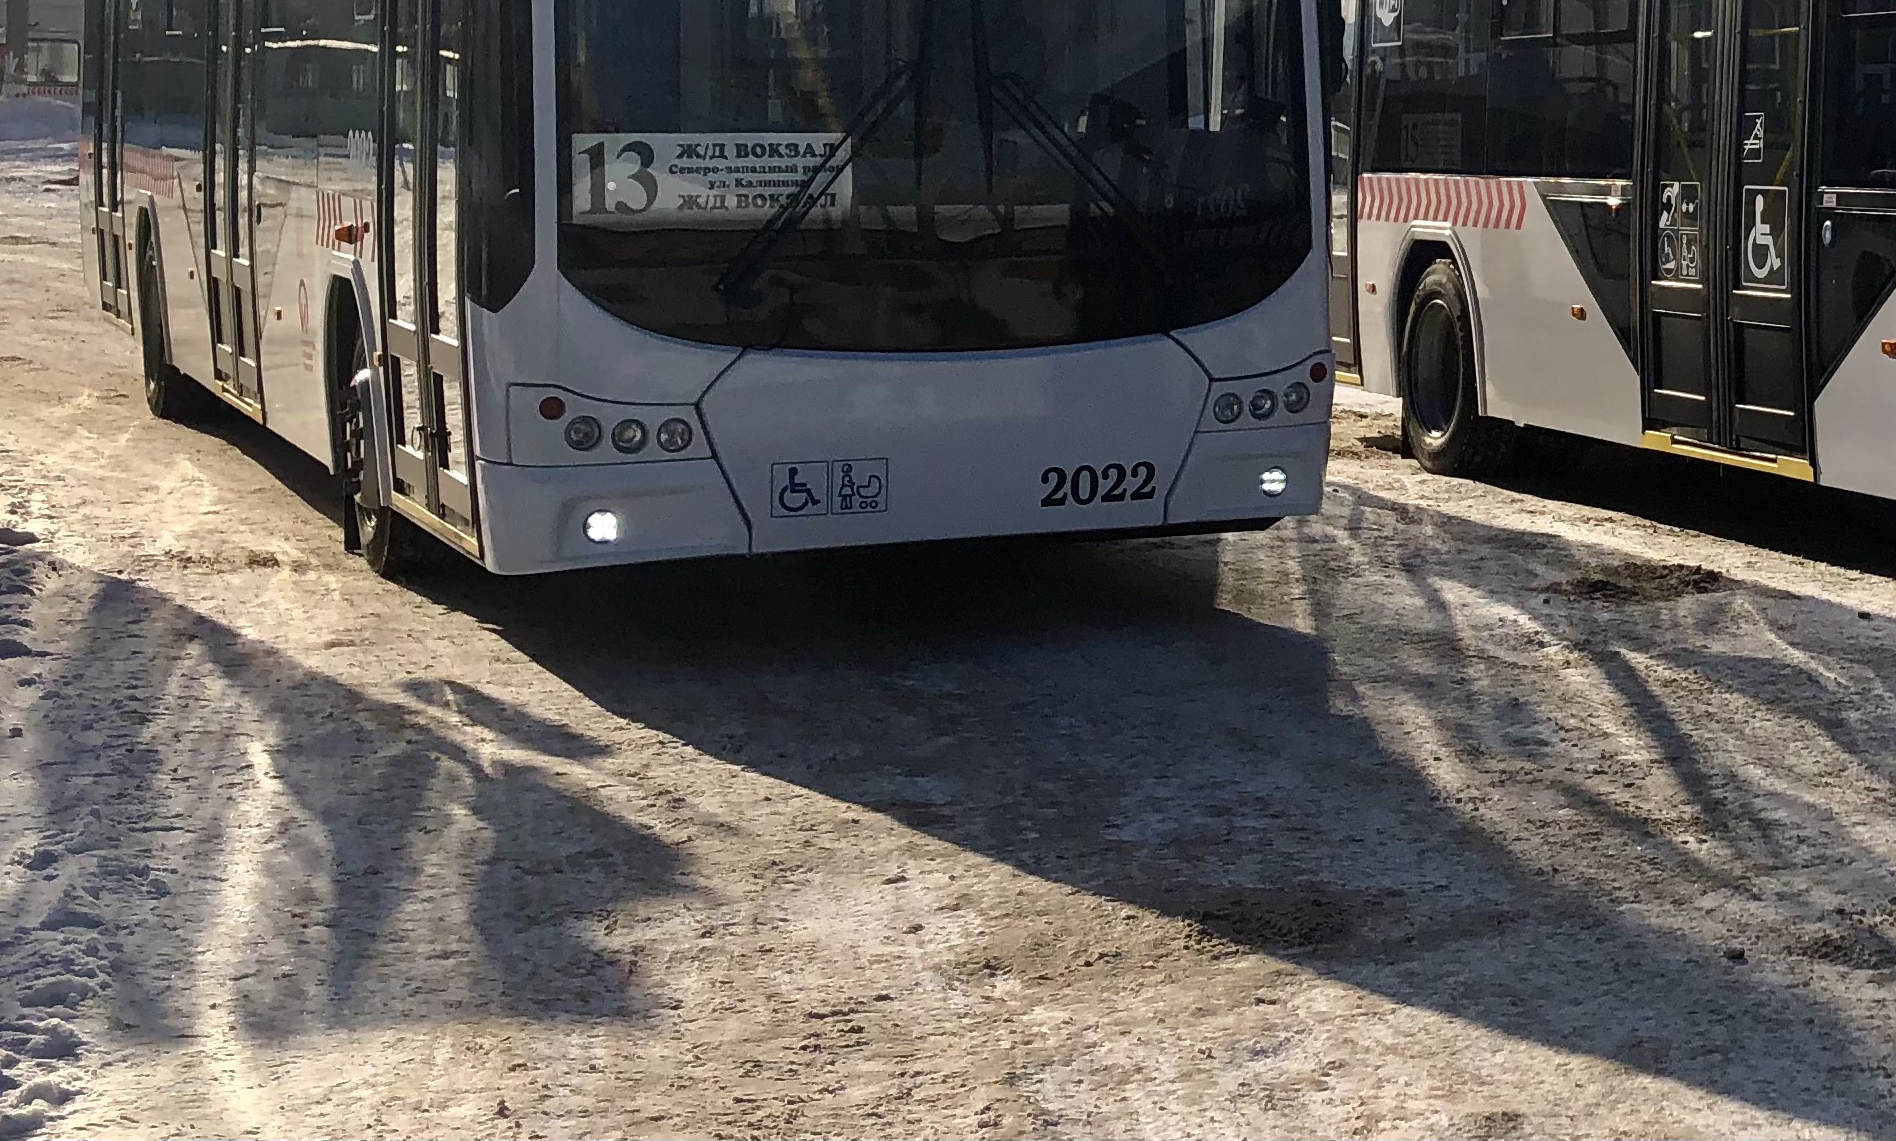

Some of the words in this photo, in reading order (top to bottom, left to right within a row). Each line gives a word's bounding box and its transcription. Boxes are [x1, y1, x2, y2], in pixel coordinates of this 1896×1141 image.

[676, 143, 729, 160] Ж/Д
[735, 143, 836, 160] ВОКЗАЛ
[577, 140, 658, 215] 13
[677, 193, 730, 211] Ж/Д
[1040, 460, 1157, 508] 2022
